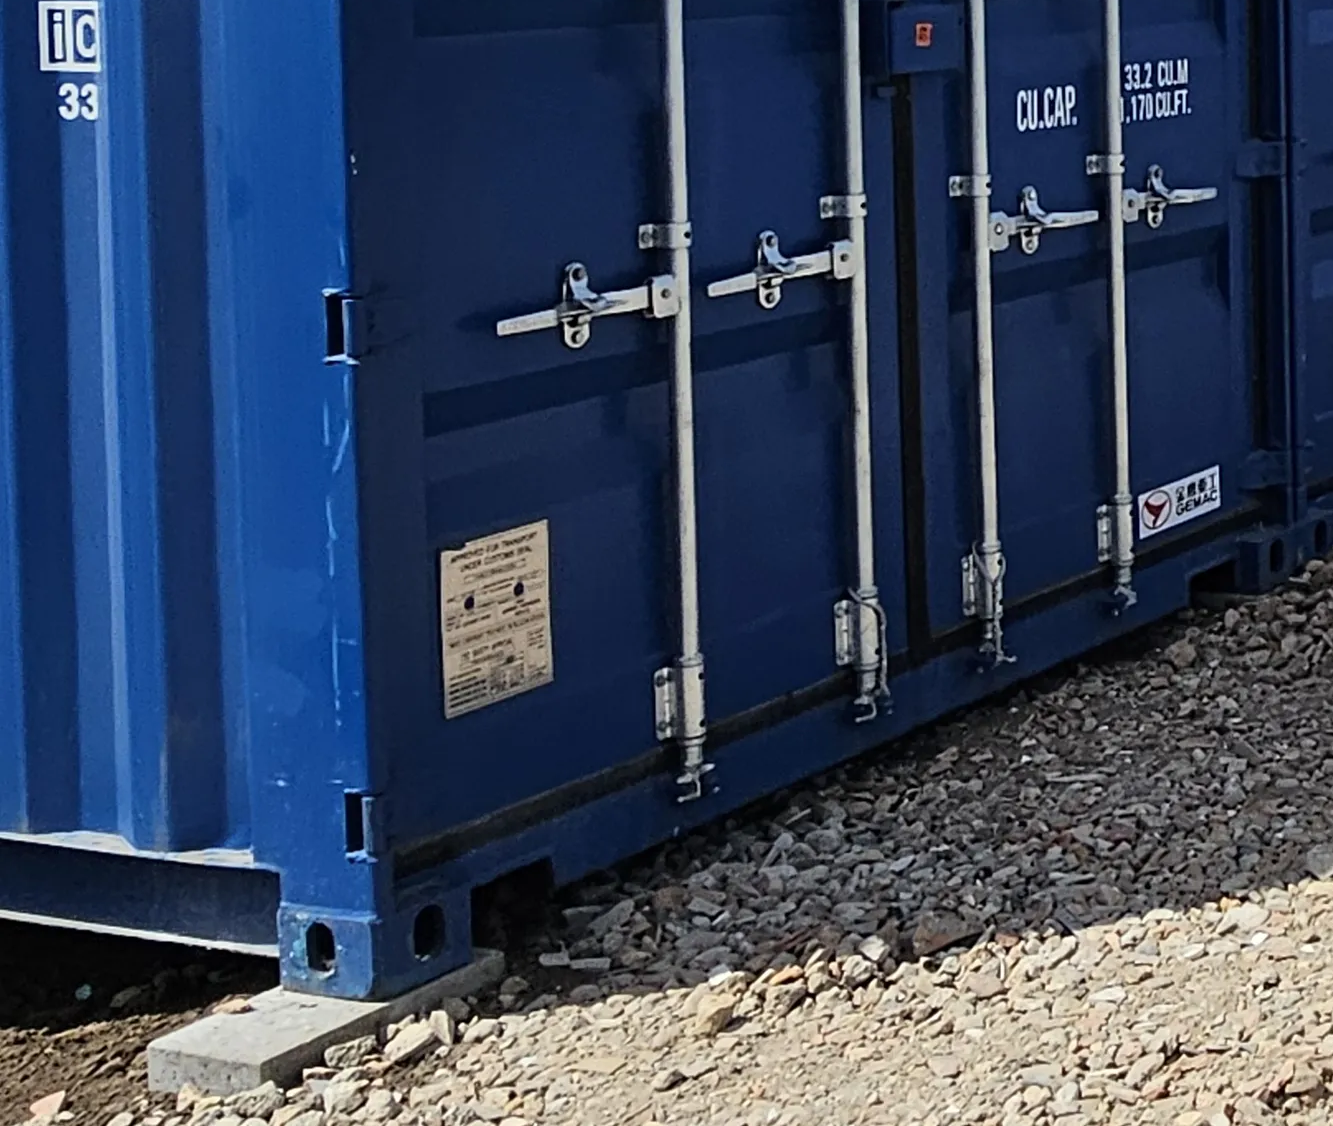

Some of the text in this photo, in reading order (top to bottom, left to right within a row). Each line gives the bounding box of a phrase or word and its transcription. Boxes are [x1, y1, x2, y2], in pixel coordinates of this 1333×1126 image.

[1124, 62, 1154, 91] 33.2
[58, 83, 98, 121] 33
[1016, 84, 1078, 133] CU.CAP.
